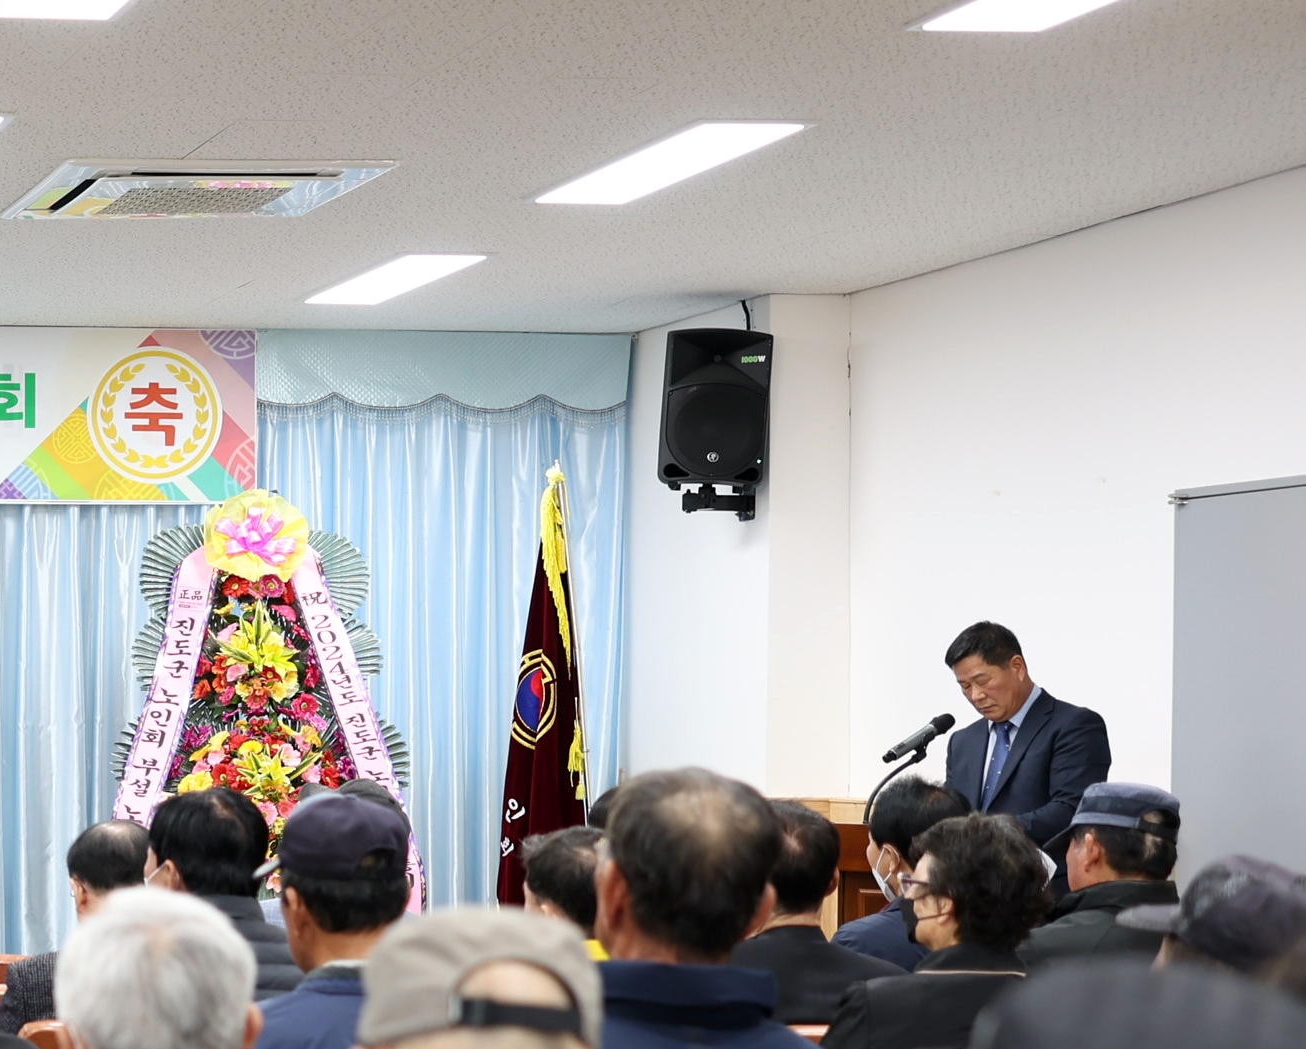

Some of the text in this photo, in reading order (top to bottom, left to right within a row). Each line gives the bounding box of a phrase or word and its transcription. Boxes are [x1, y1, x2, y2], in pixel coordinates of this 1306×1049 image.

[741, 355, 766, 363] 1000W
[125, 382, 183, 447] 축
[164, 617, 195, 679] 진도군
[141, 687, 180, 748] 노인회
[310, 614, 390, 789] 2024년도 진도군 노
[127, 757, 161, 797] 부설
